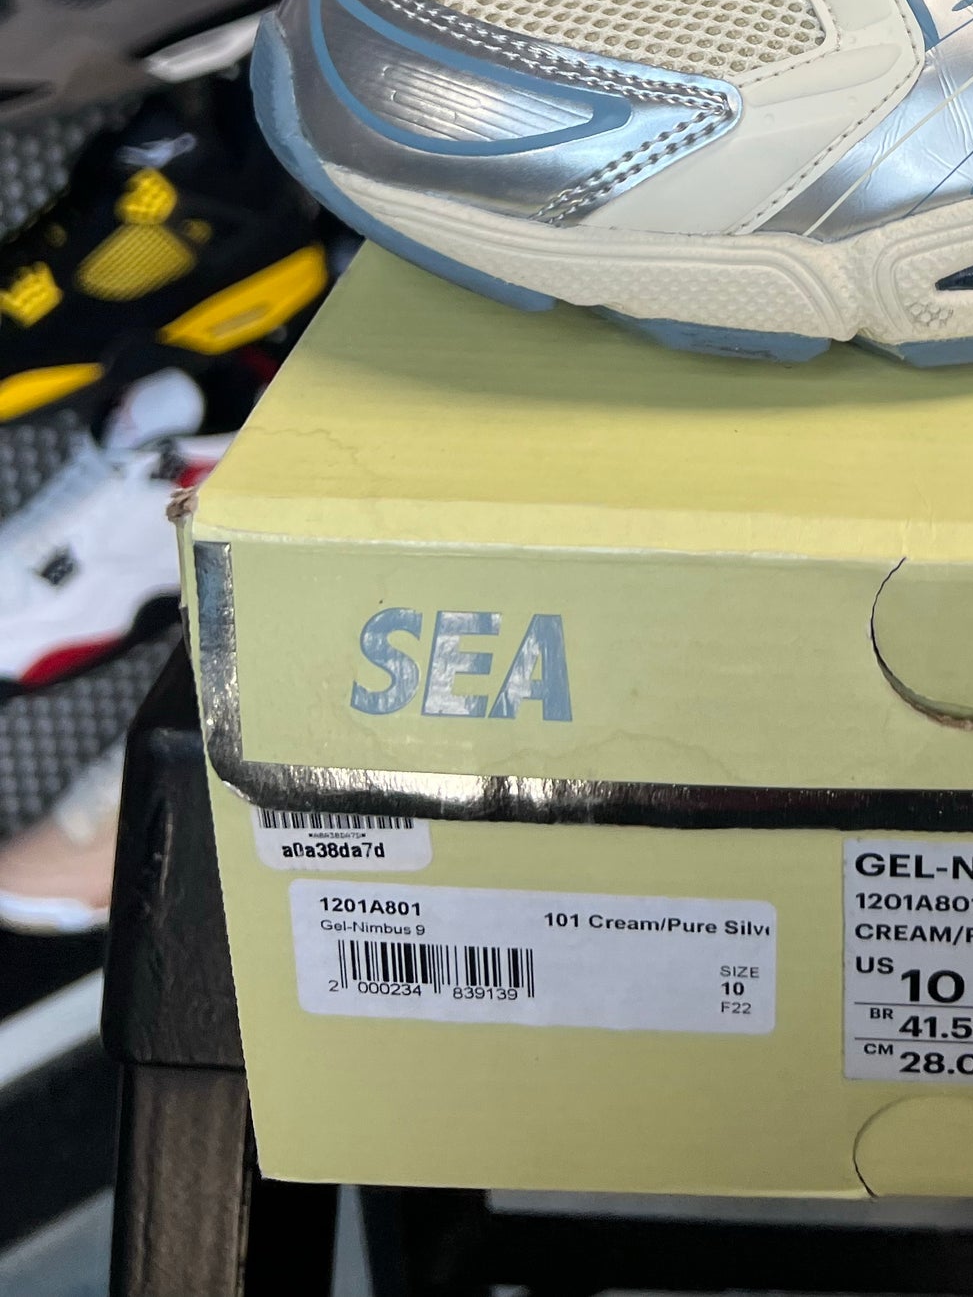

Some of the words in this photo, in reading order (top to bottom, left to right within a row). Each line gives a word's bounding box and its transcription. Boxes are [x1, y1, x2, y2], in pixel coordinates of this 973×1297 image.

[350, 607, 573, 722] SEA
[319, 897, 421, 917] 1201A801
[320, 919, 411, 935] Gel-Nimbus
[415, 924, 425, 936] 9
[544, 912, 579, 928] 101
[588, 914, 717, 935] Cream/Pure
[719, 965, 760, 979] SIZE
[855, 956, 894, 975] US
[900, 968, 965, 1003] 10
[328, 980, 339, 992] 2
[358, 981, 422, 996] 000234
[453, 987, 518, 1001] 839139
[720, 981, 745, 996] 10
[720, 1002, 751, 1015] F22
[869, 1007, 893, 1020] BR
[899, 1015, 973, 1039] 41.5
[863, 1042, 894, 1056] CM
